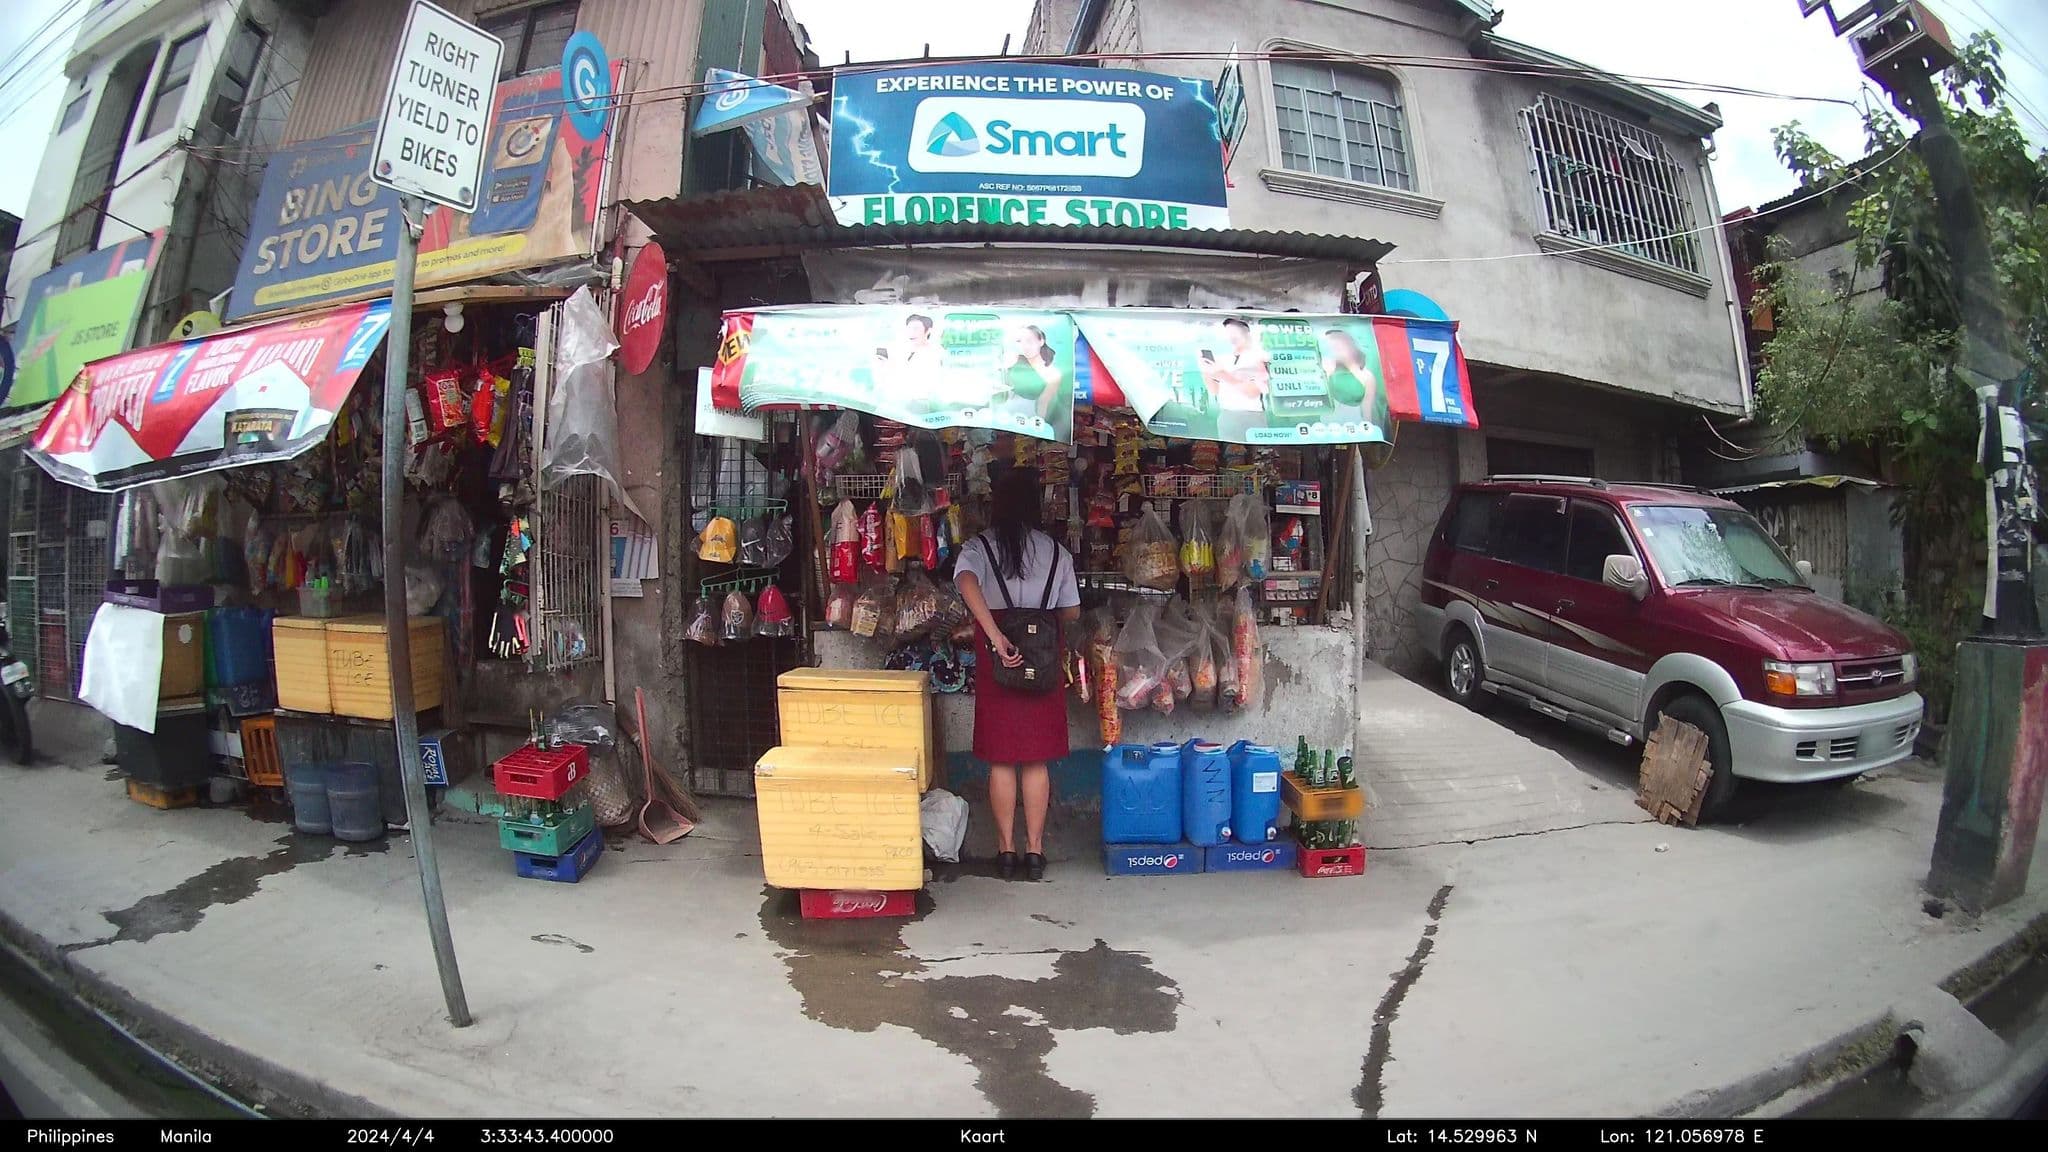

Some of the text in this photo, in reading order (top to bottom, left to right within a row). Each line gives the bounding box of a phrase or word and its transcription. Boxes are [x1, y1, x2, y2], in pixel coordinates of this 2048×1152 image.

[425, 32, 479, 73] RIGHT
[409, 60, 479, 111] TURNER
[876, 75, 1174, 100] EXPERIENCE THE POWER OF
[398, 94, 479, 146] YIELD TO
[985, 119, 1127, 158] Smart
[401, 137, 458, 177] BIKES
[281, 167, 378, 227] BING
[864, 196, 1188, 229] FLORENCE STORE
[252, 207, 390, 276] STORE
[421, 259, 430, 267] to
[431, 254, 461, 267] promos
[463, 248, 479, 259] and
[1412, 337, 1450, 413] 7
[333, 649, 374, 670] TUBE
[1127, 856, 1164, 868] pepsi
[1227, 851, 1261, 863] pepsi
